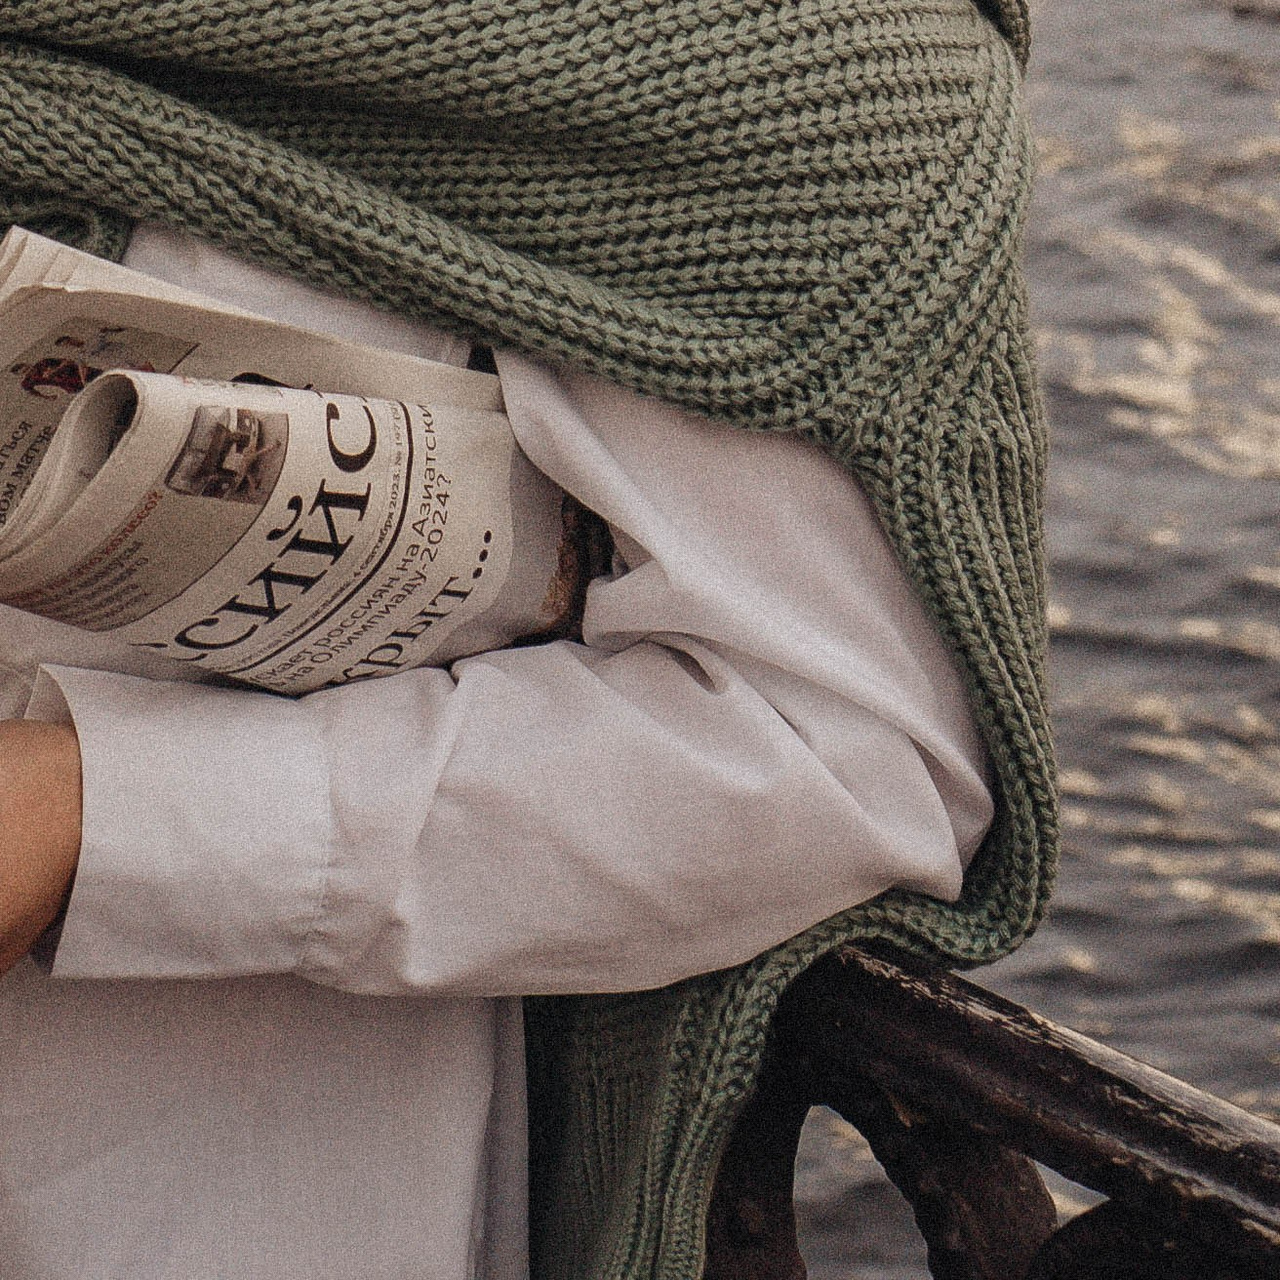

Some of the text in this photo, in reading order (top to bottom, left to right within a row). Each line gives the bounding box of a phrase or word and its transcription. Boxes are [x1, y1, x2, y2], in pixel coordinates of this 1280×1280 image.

[127, 392, 378, 661] СИЙС
[284, 665, 315, 682] на
[310, 473, 452, 664] Олимпиаду-2024?
[313, 576, 401, 648] россиян
[396, 543, 420, 572] на
[411, 404, 438, 537] Азиатски
